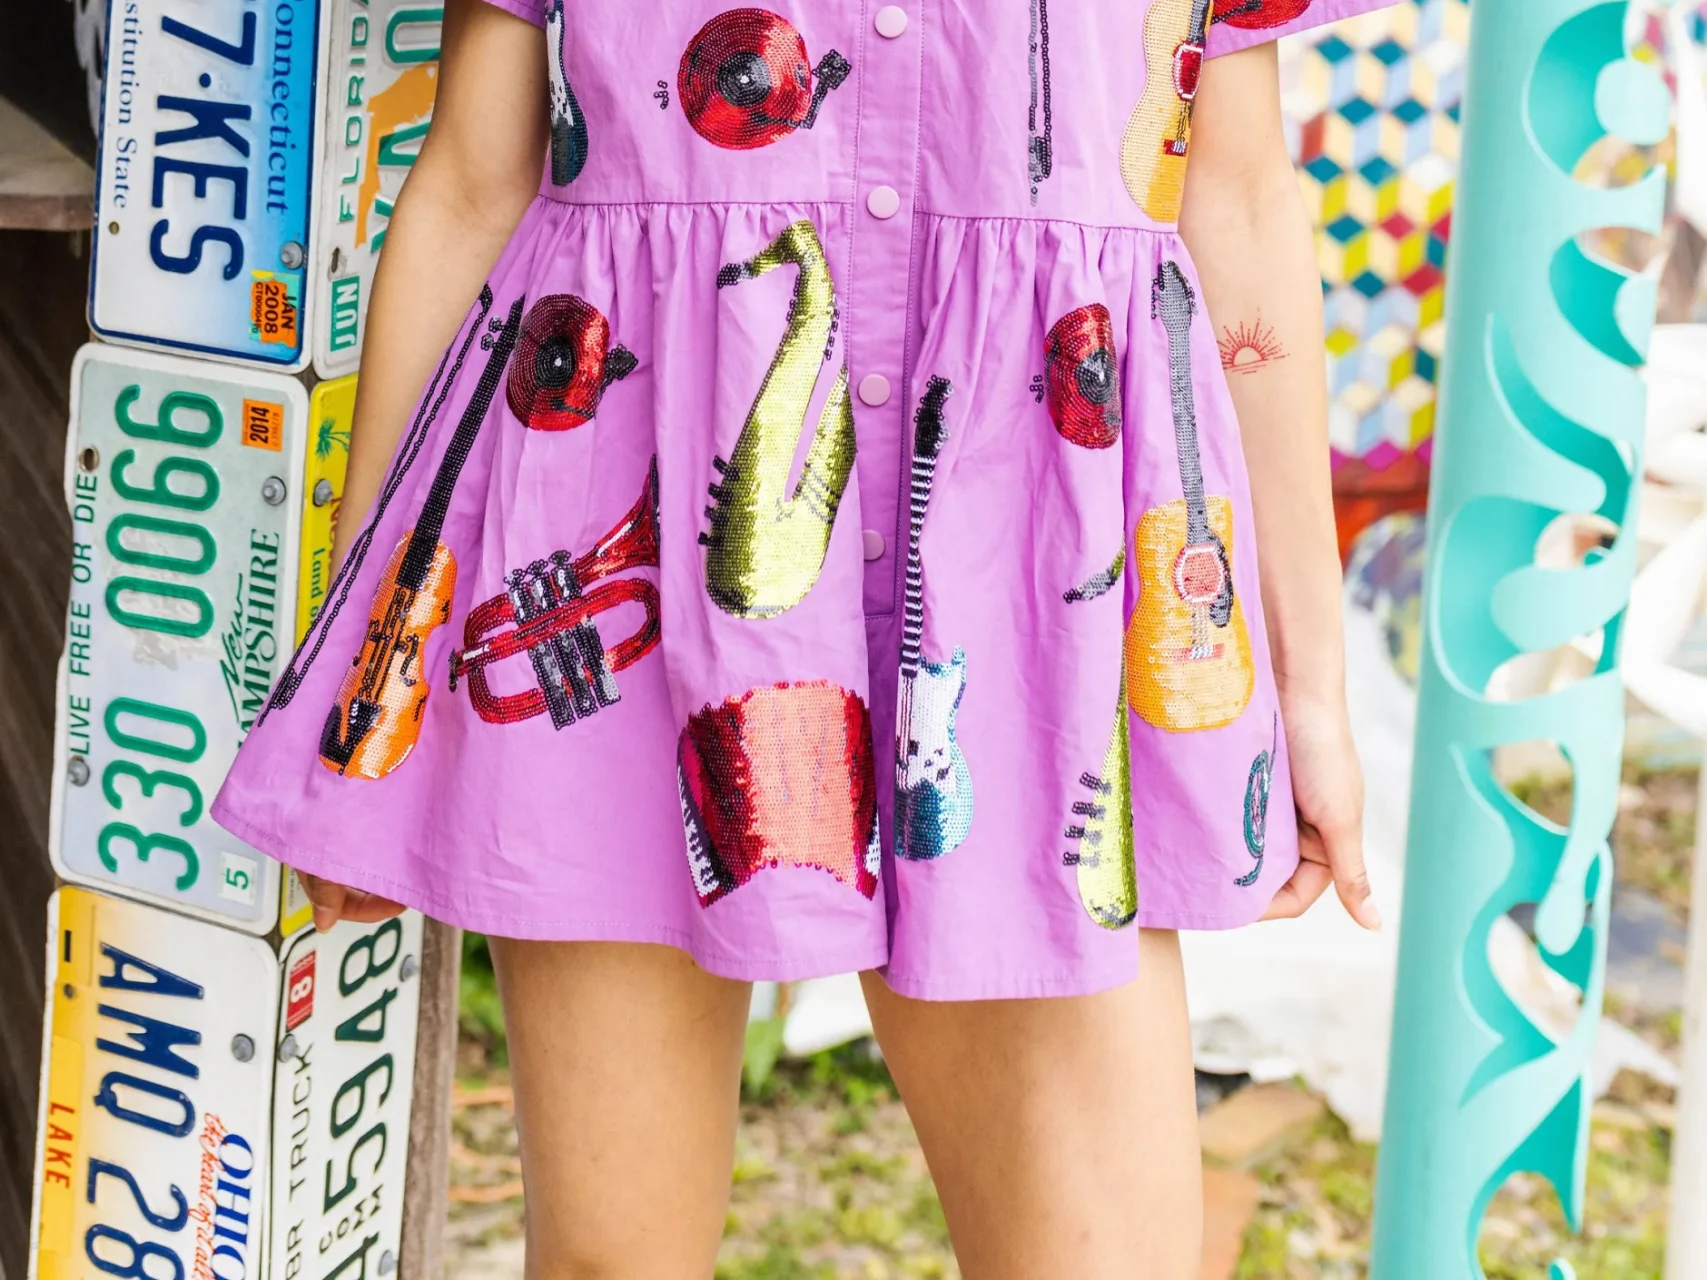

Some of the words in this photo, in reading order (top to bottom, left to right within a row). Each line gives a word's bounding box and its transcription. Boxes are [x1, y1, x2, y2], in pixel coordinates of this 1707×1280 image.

[113, 136, 138, 210] State
[264, 283, 280, 334] 2008
[281, 292, 297, 330] JAN
[334, 281, 358, 346] JUN
[249, 406, 270, 445] 2014
[74, 473, 98, 524] DIE
[105, 384, 225, 639] 0066
[72, 542, 92, 584] OR
[311, 547, 326, 599] Land
[69, 600, 91, 676] FREE
[219, 572, 244, 724] New
[237, 528, 280, 749] AMPSHIRE
[68, 695, 91, 756] LIVE
[98, 696, 208, 892] 330
[225, 867, 249, 891] 5
[289, 975, 313, 1004] 8
[92, 941, 205, 1139] AMQ
[322, 916, 403, 1216] 5948
[44, 1102, 76, 1190] LAKE
[289, 1042, 314, 1202] TRUCK
[210, 1133, 254, 1280] OHIO
